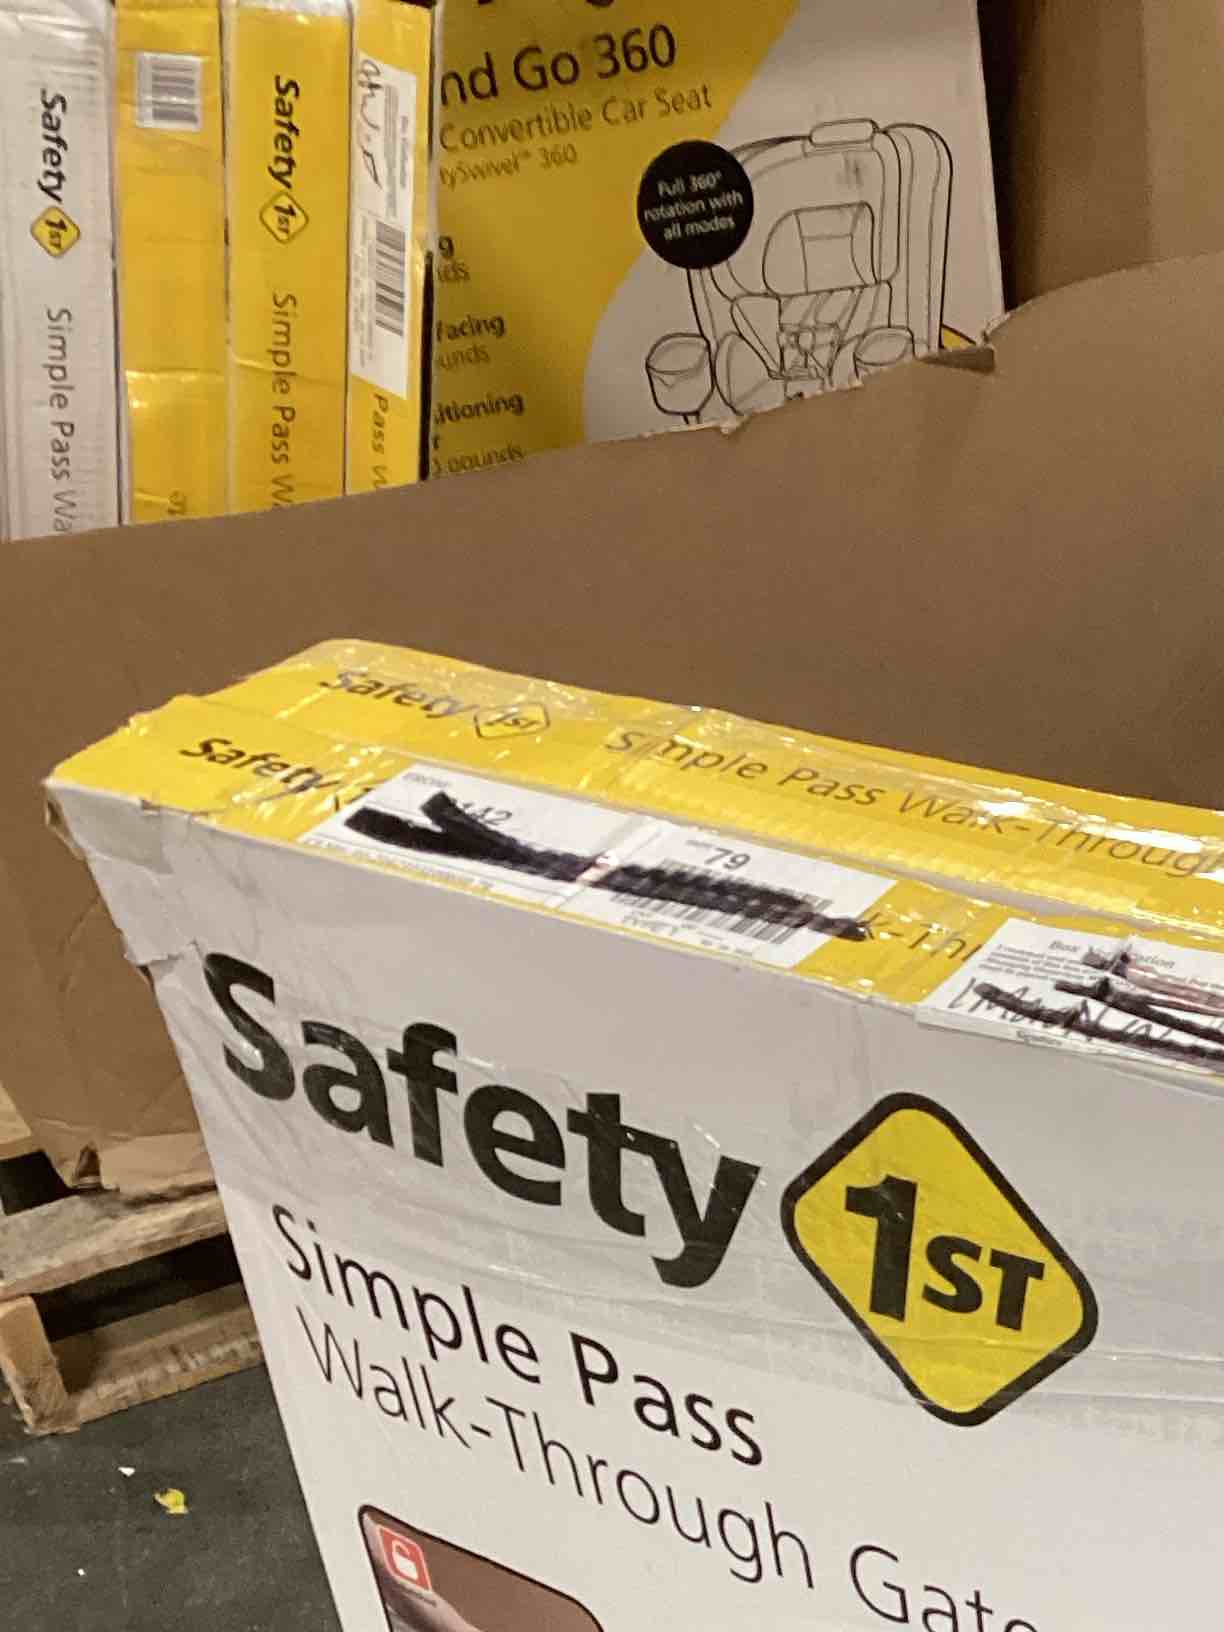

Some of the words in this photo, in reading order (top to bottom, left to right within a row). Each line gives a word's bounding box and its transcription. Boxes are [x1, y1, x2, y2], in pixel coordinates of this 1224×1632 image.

[440, 51, 499, 106] nd
[513, 45, 580, 91] Go
[592, 23, 676, 80] 360
[37, 87, 69, 204] Safety
[268, 74, 300, 190] Safety
[439, 103, 593, 153] Convertible
[601, 96, 646, 126] Car
[653, 84, 713, 117] Seat
[41, 307, 76, 411] Simple
[264, 290, 298, 395] Simple
[51, 420, 76, 482] Pass
[271, 404, 297, 465] Pass
[371, 392, 390, 456] Pass
[604, 728, 769, 782] Simple
[776, 765, 891, 808] Pass
[201, 950, 762, 1290] Safety
[271, 1202, 541, 1384] Simple
[570, 1331, 766, 1469] Pass
[295, 1305, 816, 1591] Walk-Through
